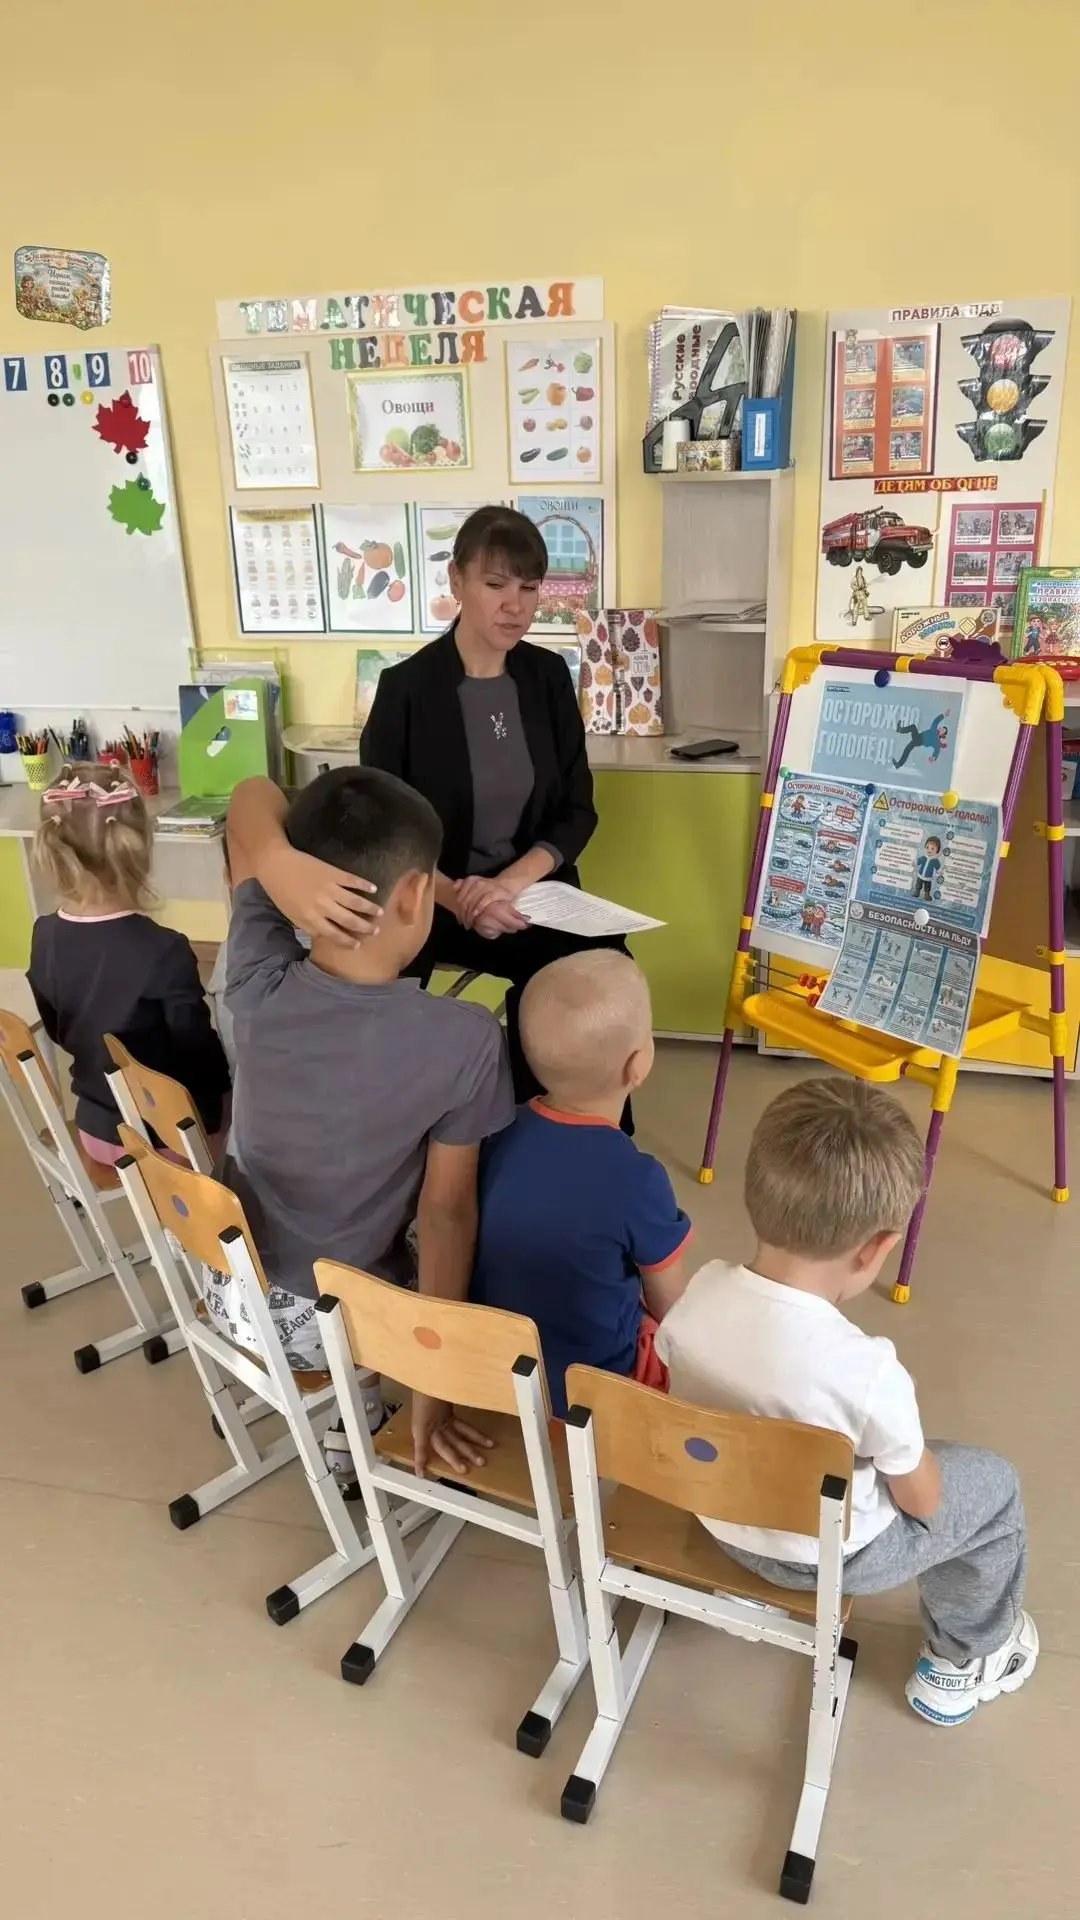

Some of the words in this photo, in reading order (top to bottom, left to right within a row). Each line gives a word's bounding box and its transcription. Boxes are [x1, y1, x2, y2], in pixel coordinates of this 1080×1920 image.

[239, 282, 576, 334] ТЕМАТИЧЕСКАЯ
[892, 306, 960, 321] ПРАВИЛА
[969, 303, 1000, 317] ПДД
[328, 330, 488, 370] НЕДЕЛЯ
[8, 360, 20, 388] 7
[50, 358, 63, 387] 8
[91, 354, 105, 384] 9
[130, 353, 151, 383] 10
[672, 333, 686, 401] Русские
[381, 399, 435, 416] Овощи
[875, 480, 926, 492] ДЕТЯМ
[930, 479, 952, 490] ОБ
[957, 477, 997, 491] ОГНЕ
[900, 611, 950, 643] ДОРОЖНЫЕ
[822, 698, 921, 730] ОСТОРОЖНО
[889, 797, 945, 815] Осторожно
[868, 910, 937, 935] БЕЗОПАСНОСТЬ
[939, 928, 950, 940] НА
[951, 933, 972, 946] ЛЬДУ
[279, 1306, 316, 1340] EAGUE
